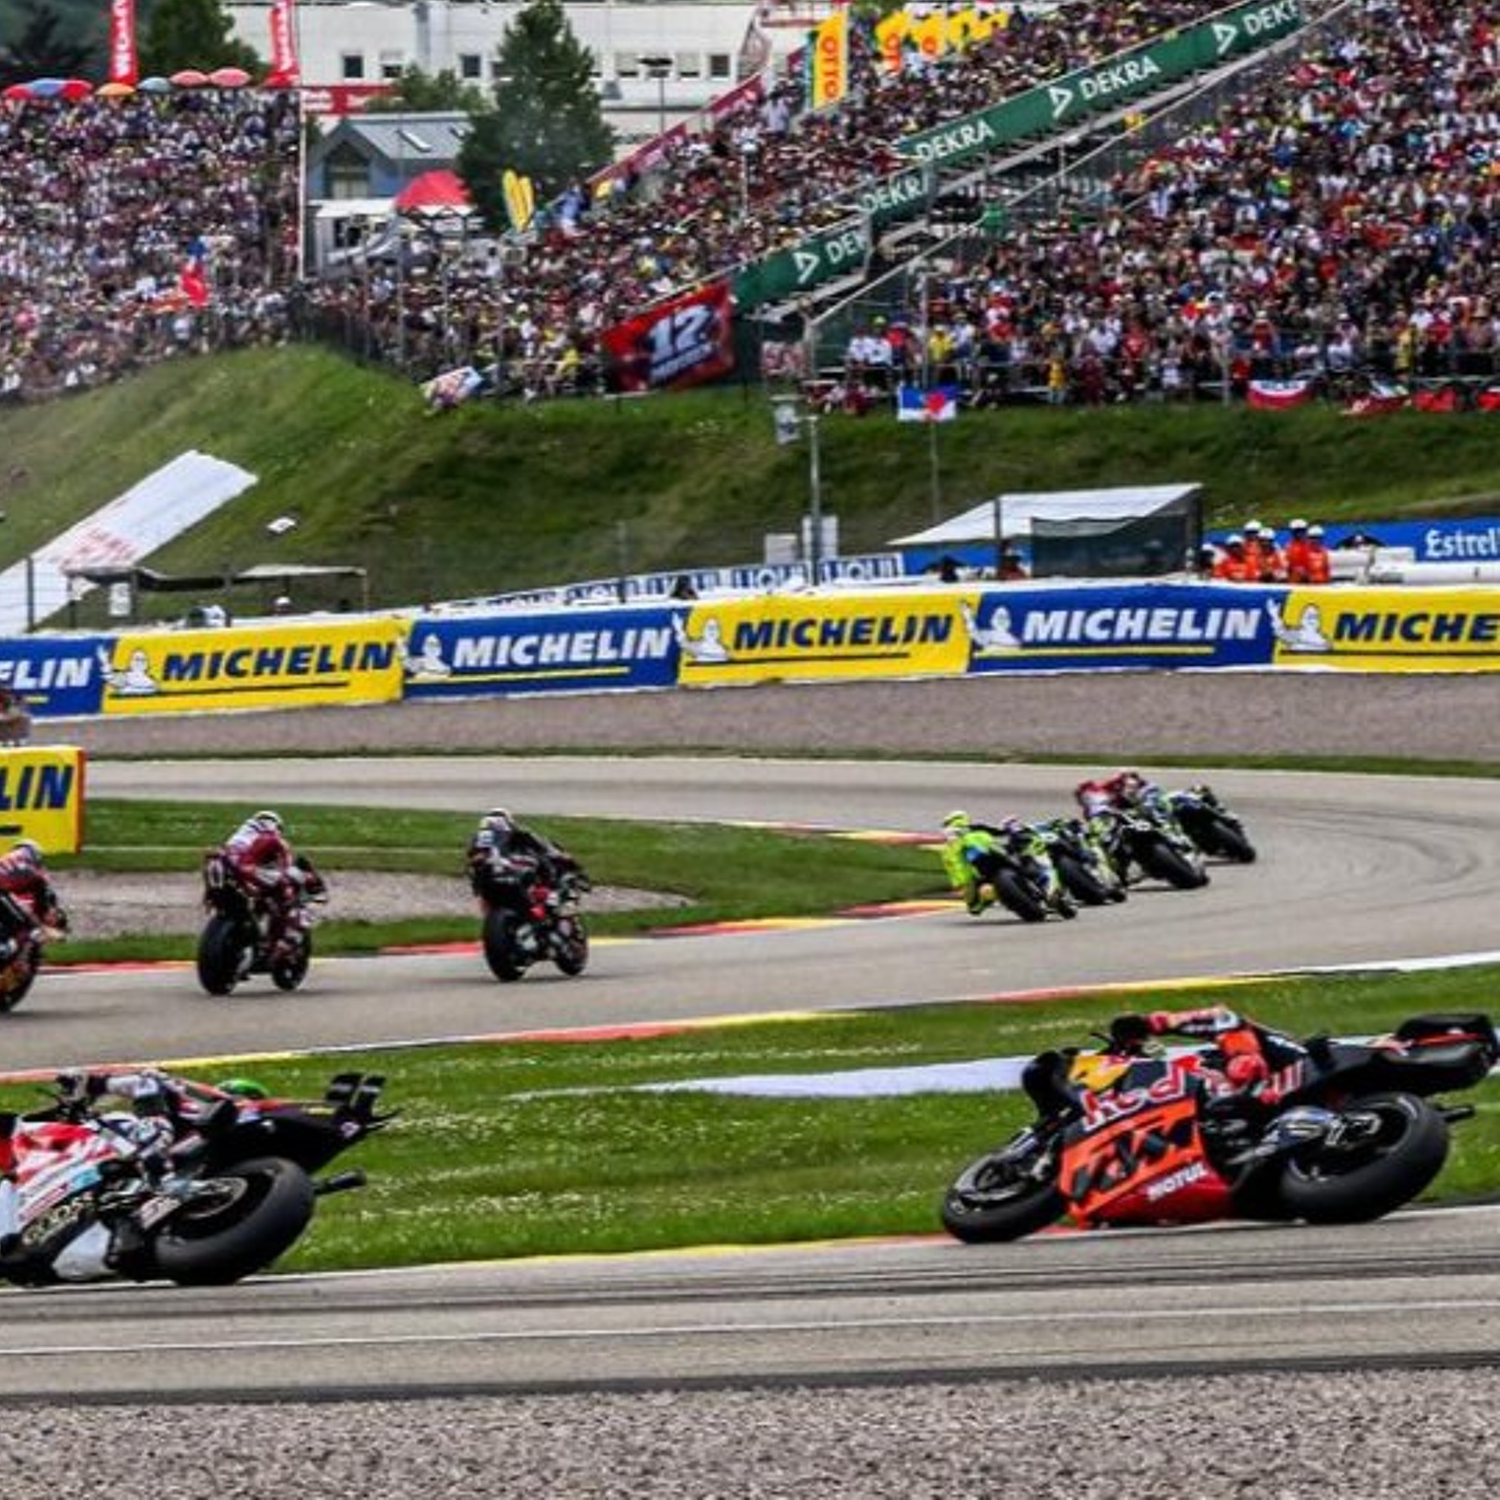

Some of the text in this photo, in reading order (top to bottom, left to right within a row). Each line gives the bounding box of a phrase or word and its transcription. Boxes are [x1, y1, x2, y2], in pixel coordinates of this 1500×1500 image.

[1080, 55, 1161, 100] DEKRA
[650, 304, 715, 360] 12
[1426, 527, 1500, 557] Estrel
[733, 614, 954, 650] MICHELIN
[1022, 607, 1262, 643] MICHELIN
[161, 640, 398, 681] MICHELIN
[452, 626, 672, 668] MICHELIN
[1146, 1160, 1209, 1201] MOTUL
